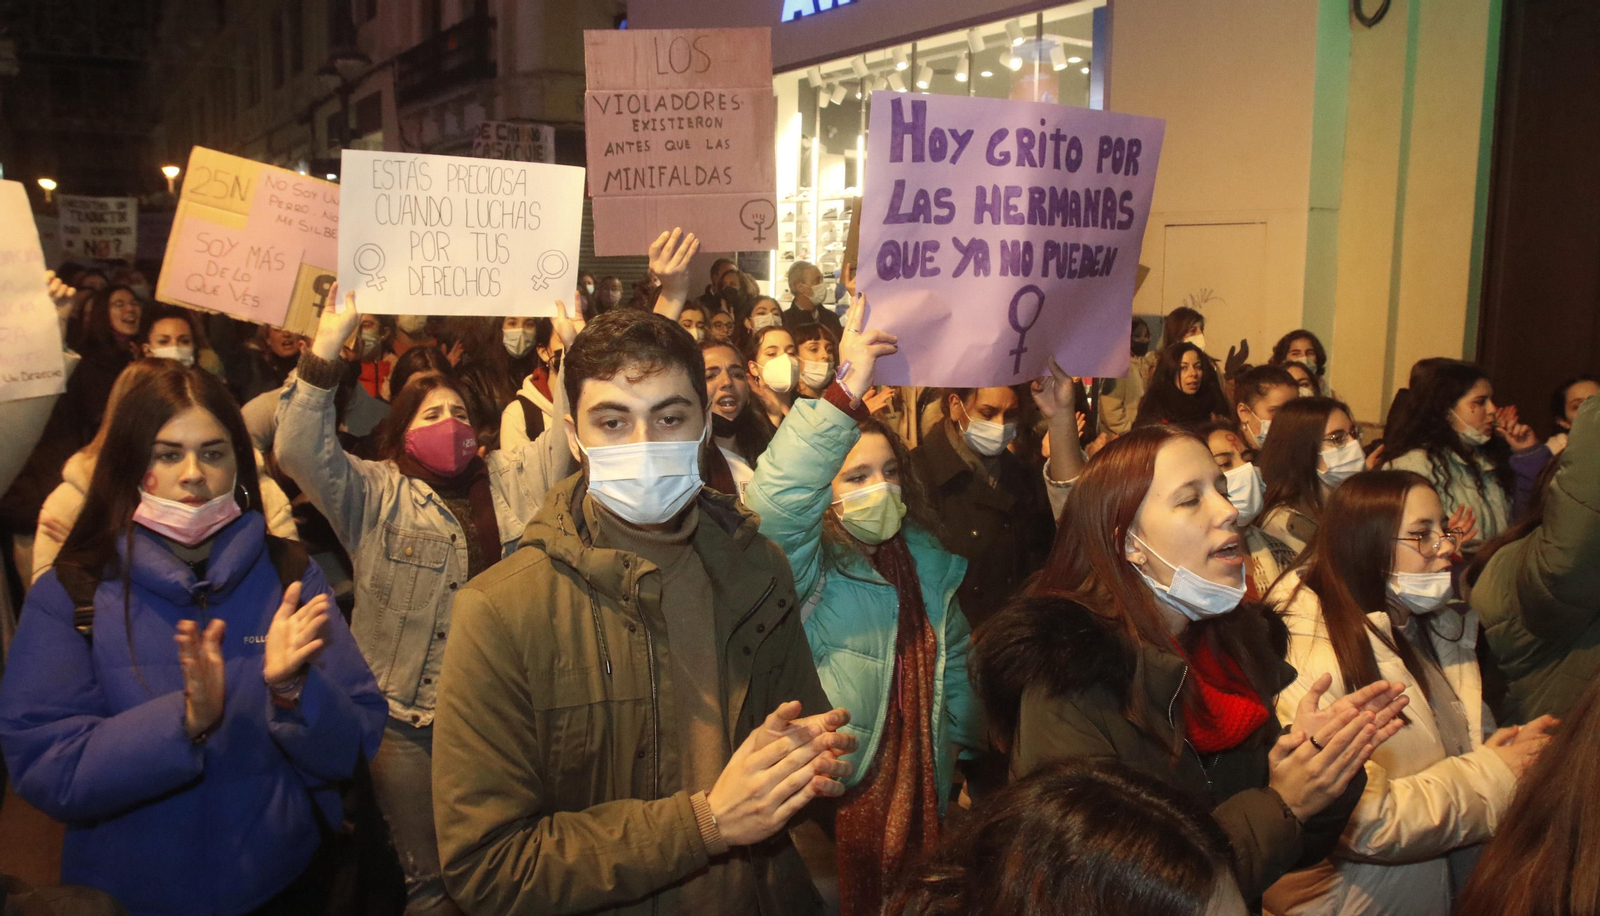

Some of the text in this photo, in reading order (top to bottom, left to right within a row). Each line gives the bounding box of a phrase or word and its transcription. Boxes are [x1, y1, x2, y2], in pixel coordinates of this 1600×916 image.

[653, 34, 711, 75] LOS
[592, 91, 741, 115] VIOLADORES
[632, 117, 723, 132] EXISTIERON
[605, 138, 730, 157] ANTES QUE LAS
[1096, 135, 1142, 176] POR
[189, 166, 250, 202] 25N
[265, 175, 287, 191] NO
[372, 157, 527, 196] ESTÁS PRECIOSA
[603, 165, 732, 192] MINIFALDAS
[375, 193, 541, 230] CUANDO LUCHAS
[883, 179, 1135, 230] LAS HERMANAS
[195, 232, 285, 272] SOY MÁS
[410, 230, 510, 264] POR TUS
[876, 236, 1118, 282] QUE YA NO PUEDEN
[205, 260, 229, 278] DE
[408, 265, 501, 297] DERECHOS
